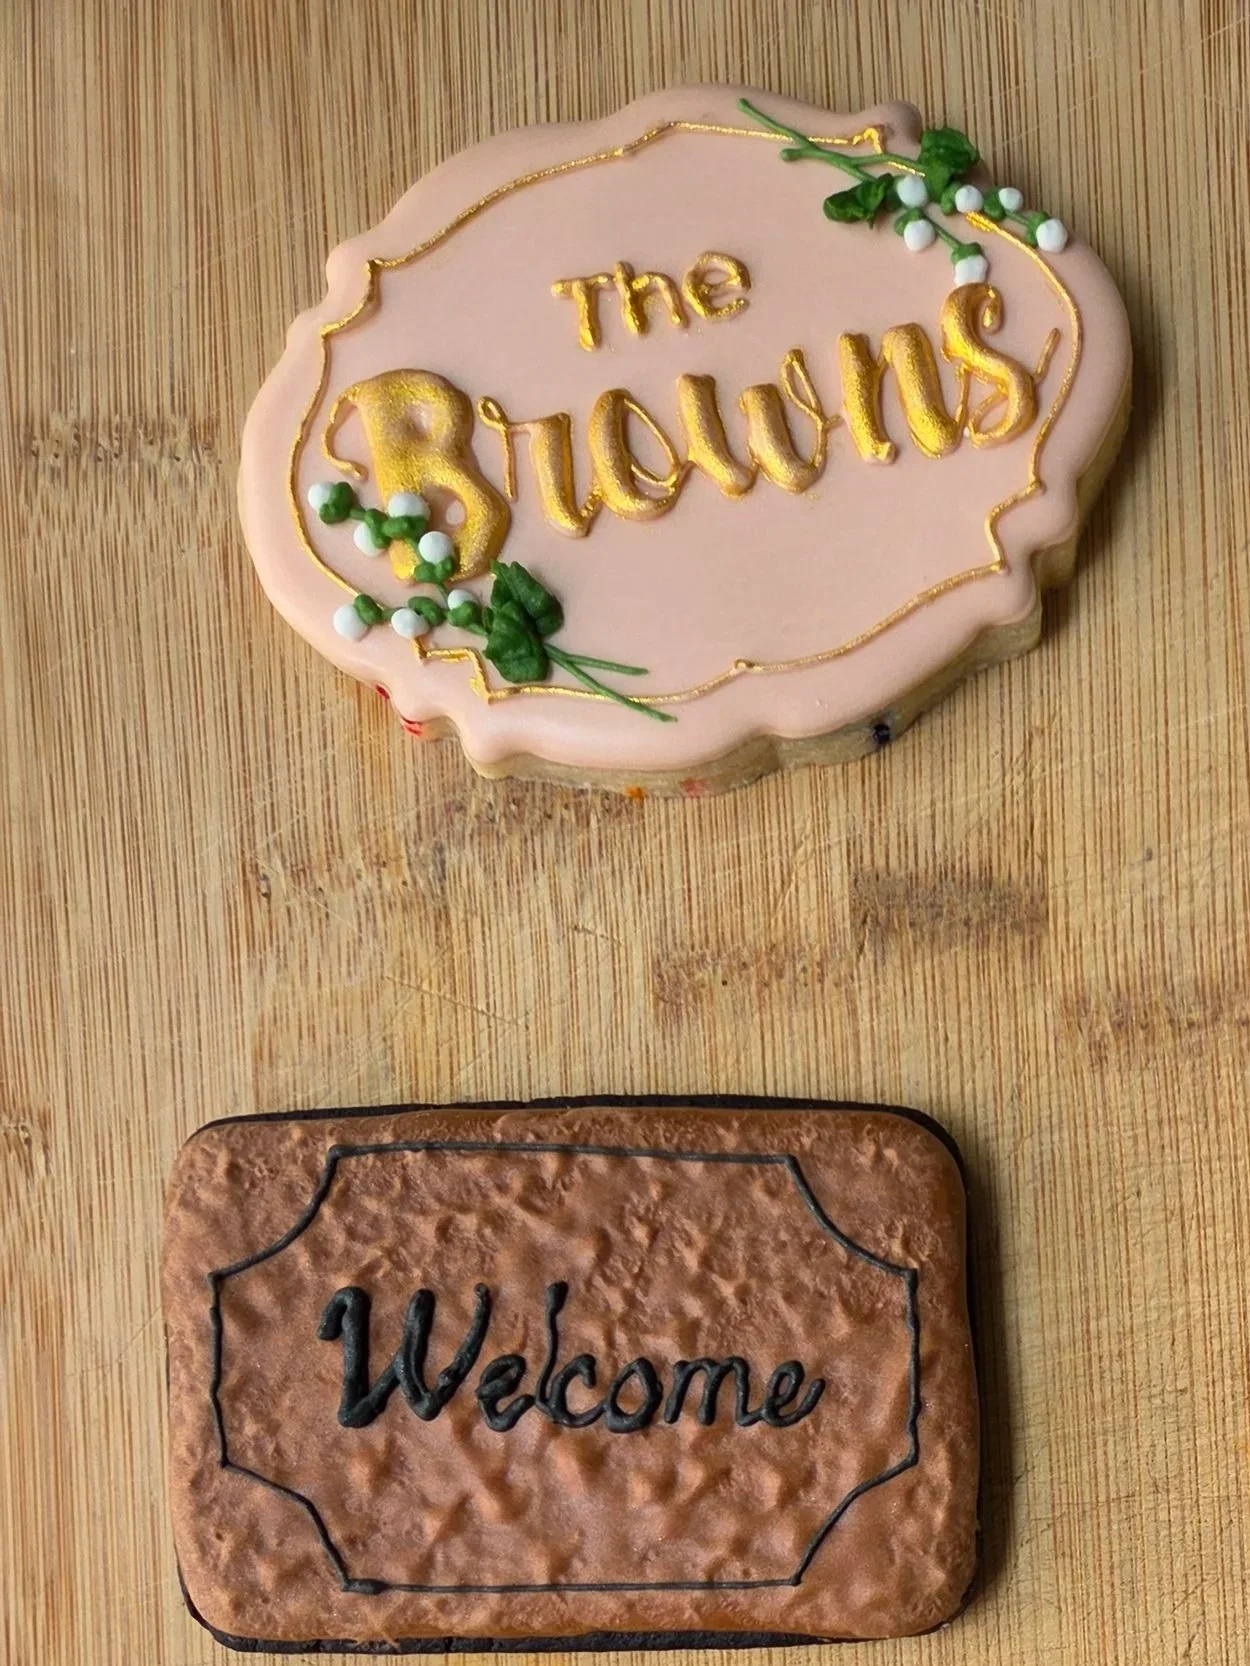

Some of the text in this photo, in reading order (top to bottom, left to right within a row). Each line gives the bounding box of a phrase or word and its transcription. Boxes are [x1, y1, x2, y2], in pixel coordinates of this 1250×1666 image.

[551, 252, 752, 352] The
[321, 282, 1061, 583] Browns
[317, 1280, 826, 1434] Welcome
